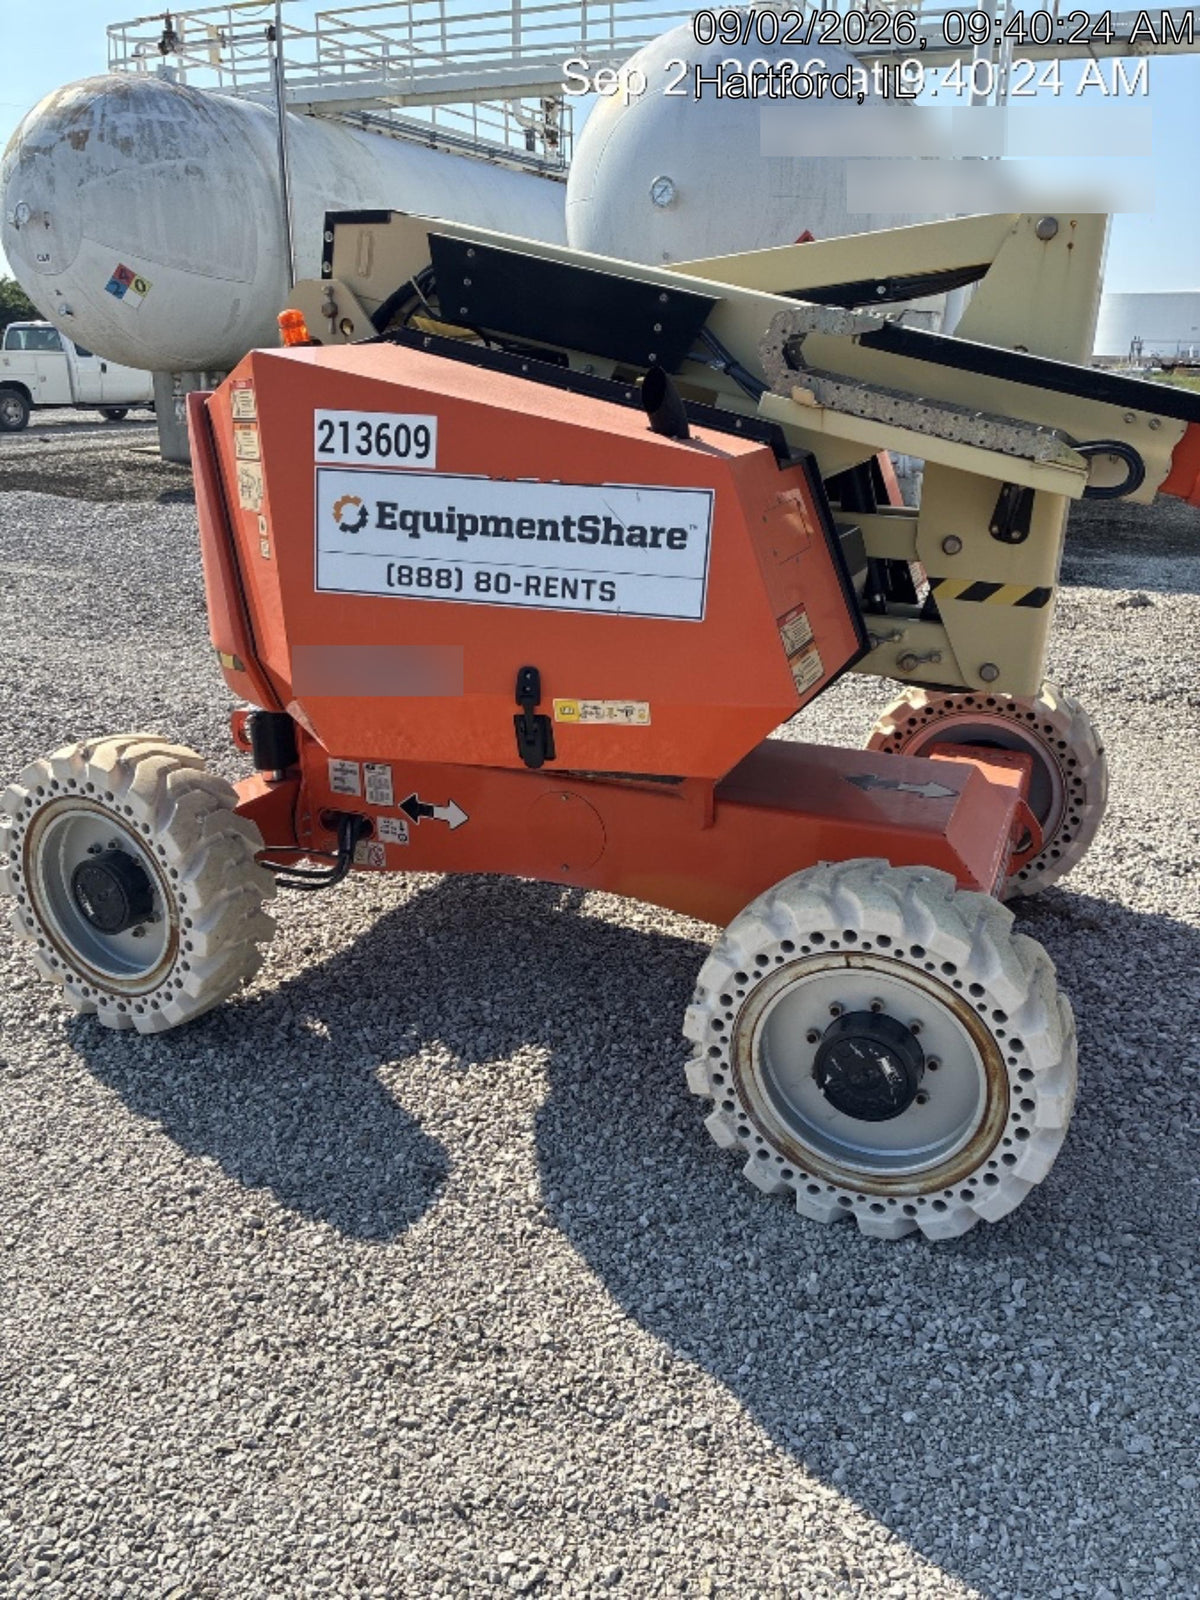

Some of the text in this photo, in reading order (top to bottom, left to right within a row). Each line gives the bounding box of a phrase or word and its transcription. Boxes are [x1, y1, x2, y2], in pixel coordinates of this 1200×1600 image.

[317, 418, 431, 459] 213609
[386, 562, 617, 602] (888) 80-RENTS
